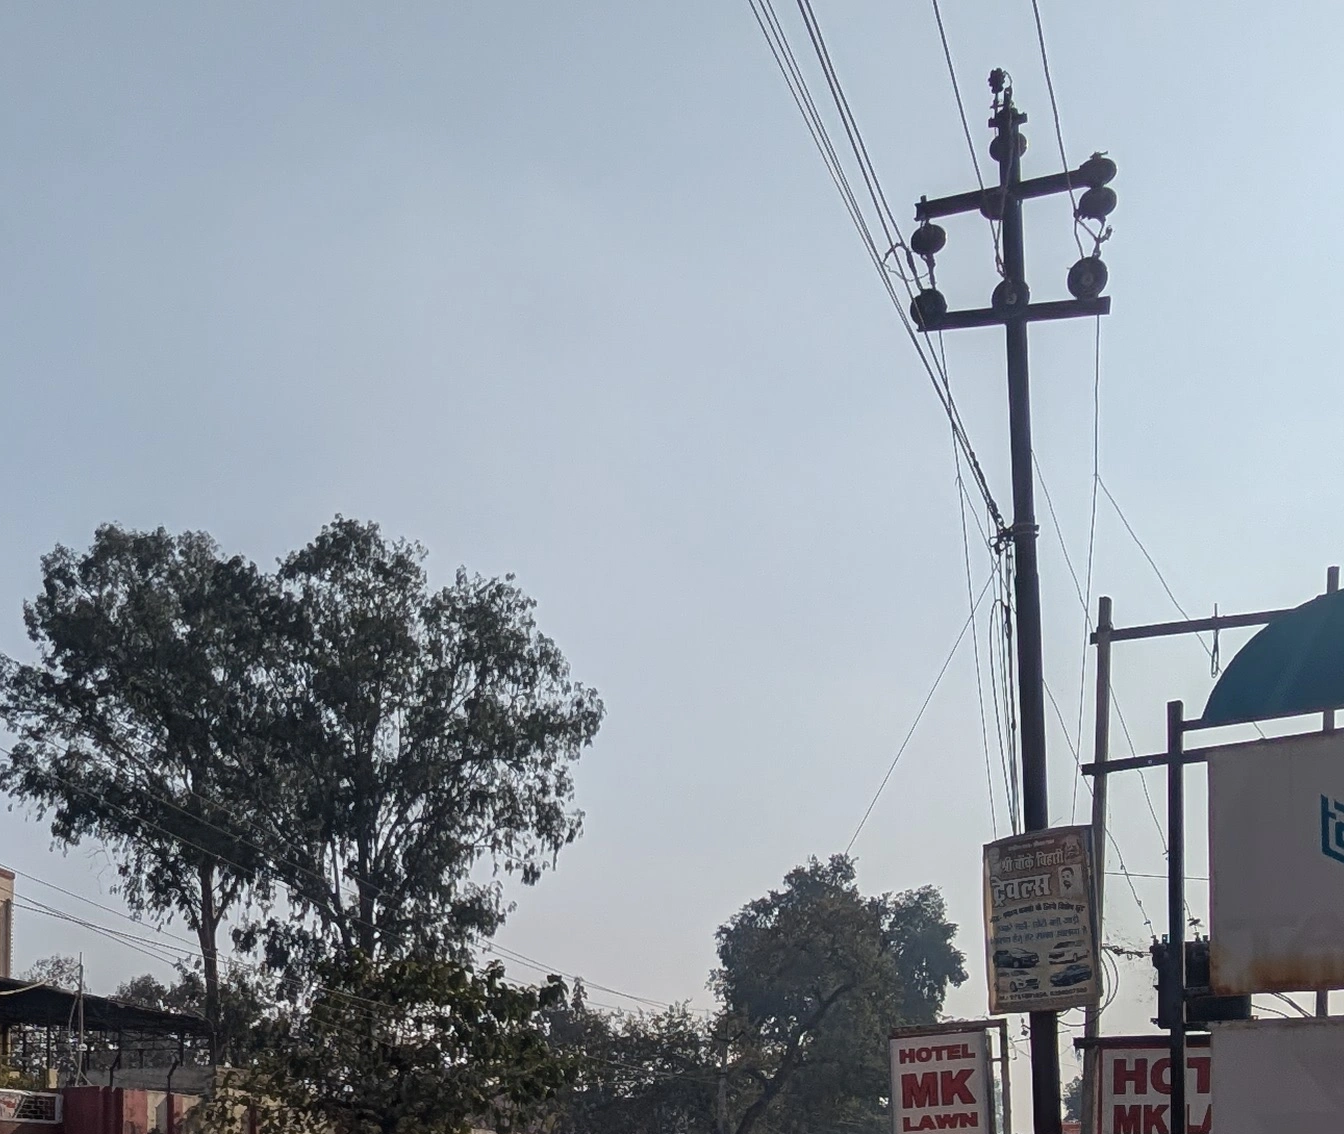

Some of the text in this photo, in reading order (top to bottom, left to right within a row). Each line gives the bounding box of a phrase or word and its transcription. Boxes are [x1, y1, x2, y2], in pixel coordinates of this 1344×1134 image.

[899, 1043, 976, 1065] HOTEL
[901, 1069, 977, 1109] MK
[1113, 1057, 1211, 1095] HOT
[903, 1112, 979, 1132] LAWN
[1113, 1104, 1169, 1134] MK
